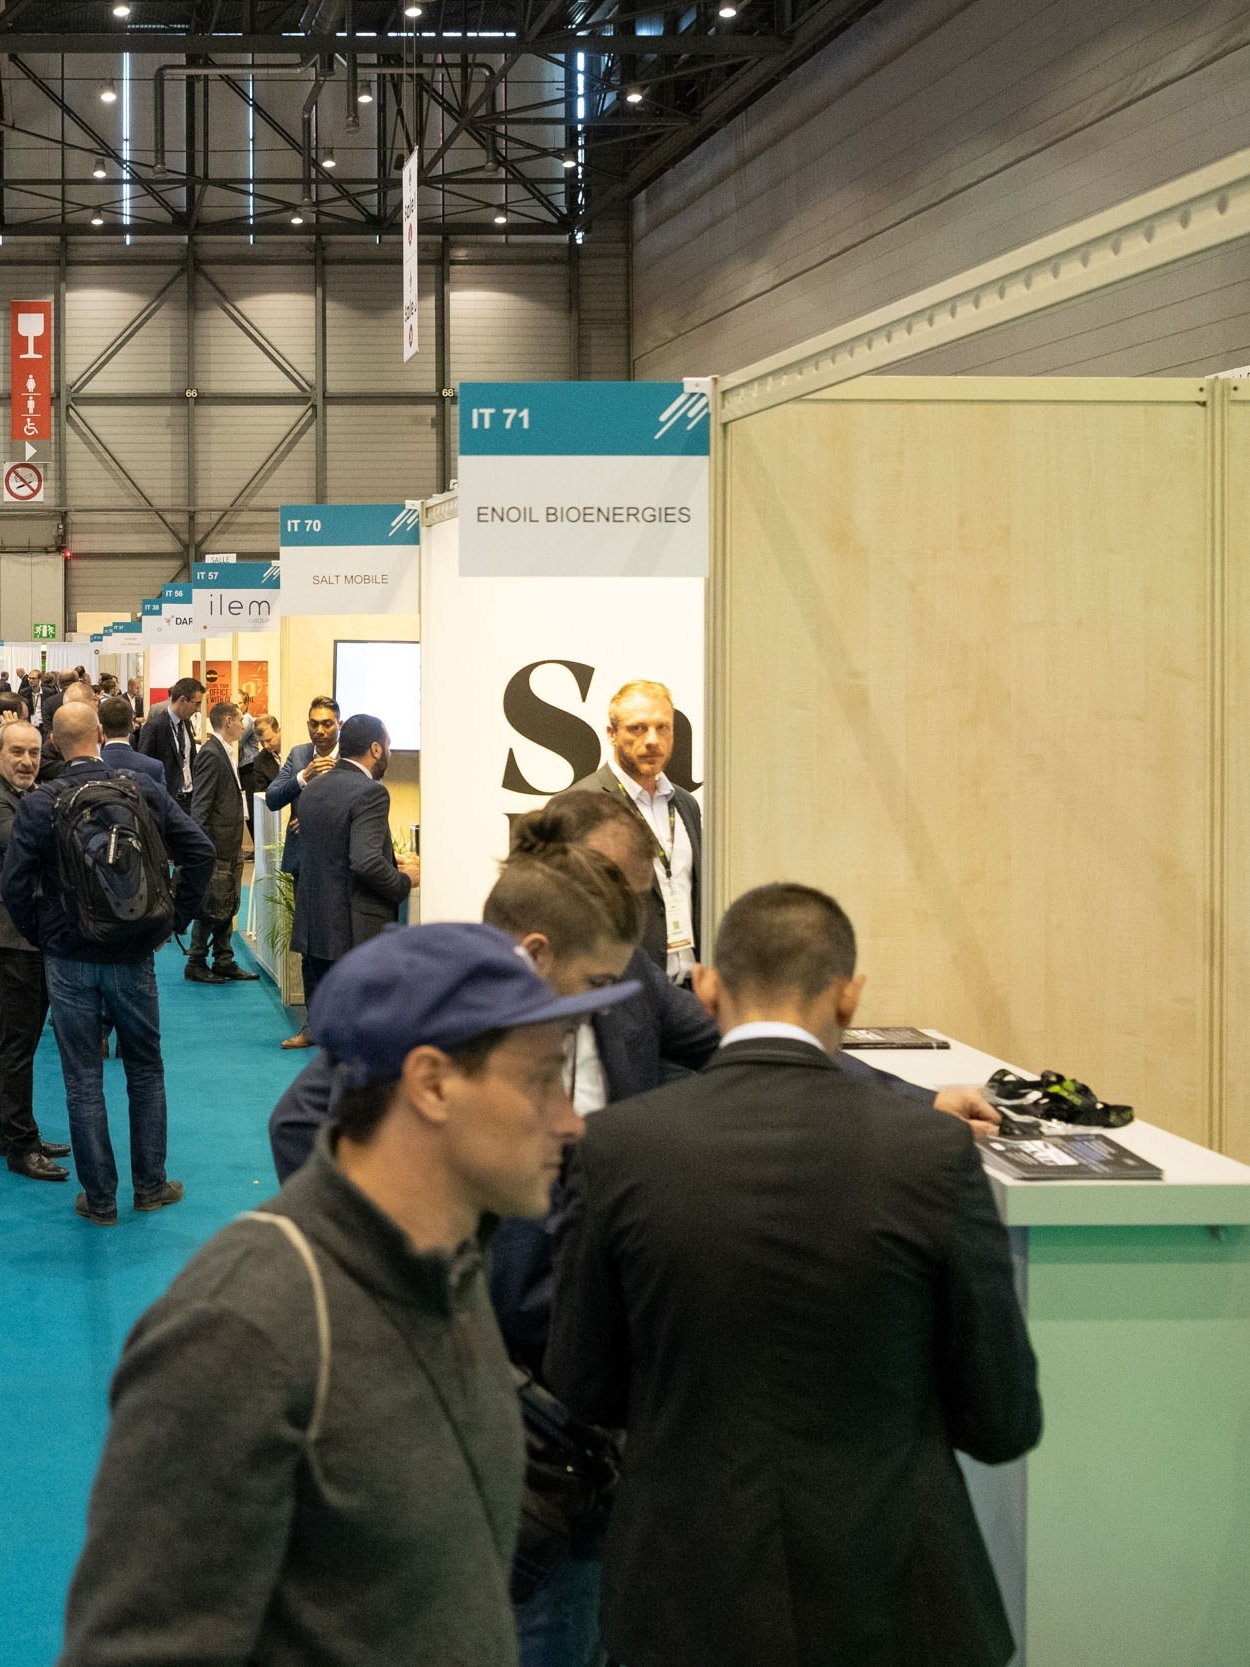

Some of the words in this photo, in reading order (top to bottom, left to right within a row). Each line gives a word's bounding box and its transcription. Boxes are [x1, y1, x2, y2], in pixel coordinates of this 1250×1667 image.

[185, 389, 198, 398] 66
[441, 388, 454, 397] 68
[472, 408, 495, 429] IT
[503, 408, 529, 429] 71
[477, 506, 539, 523] ENOIL
[546, 506, 691, 523] BIOENERGIES
[287, 520, 301, 533] IT
[304, 520, 322, 533] 70
[197, 571, 206, 580] IT
[208, 571, 219, 580] 57
[312, 574, 341, 585] SALT
[344, 574, 390, 585] MOBILE
[165, 590, 173, 598] IT
[174, 590, 184, 598] 56
[209, 593, 271, 616] ilem
[209, 688, 229, 696] OFFICE
